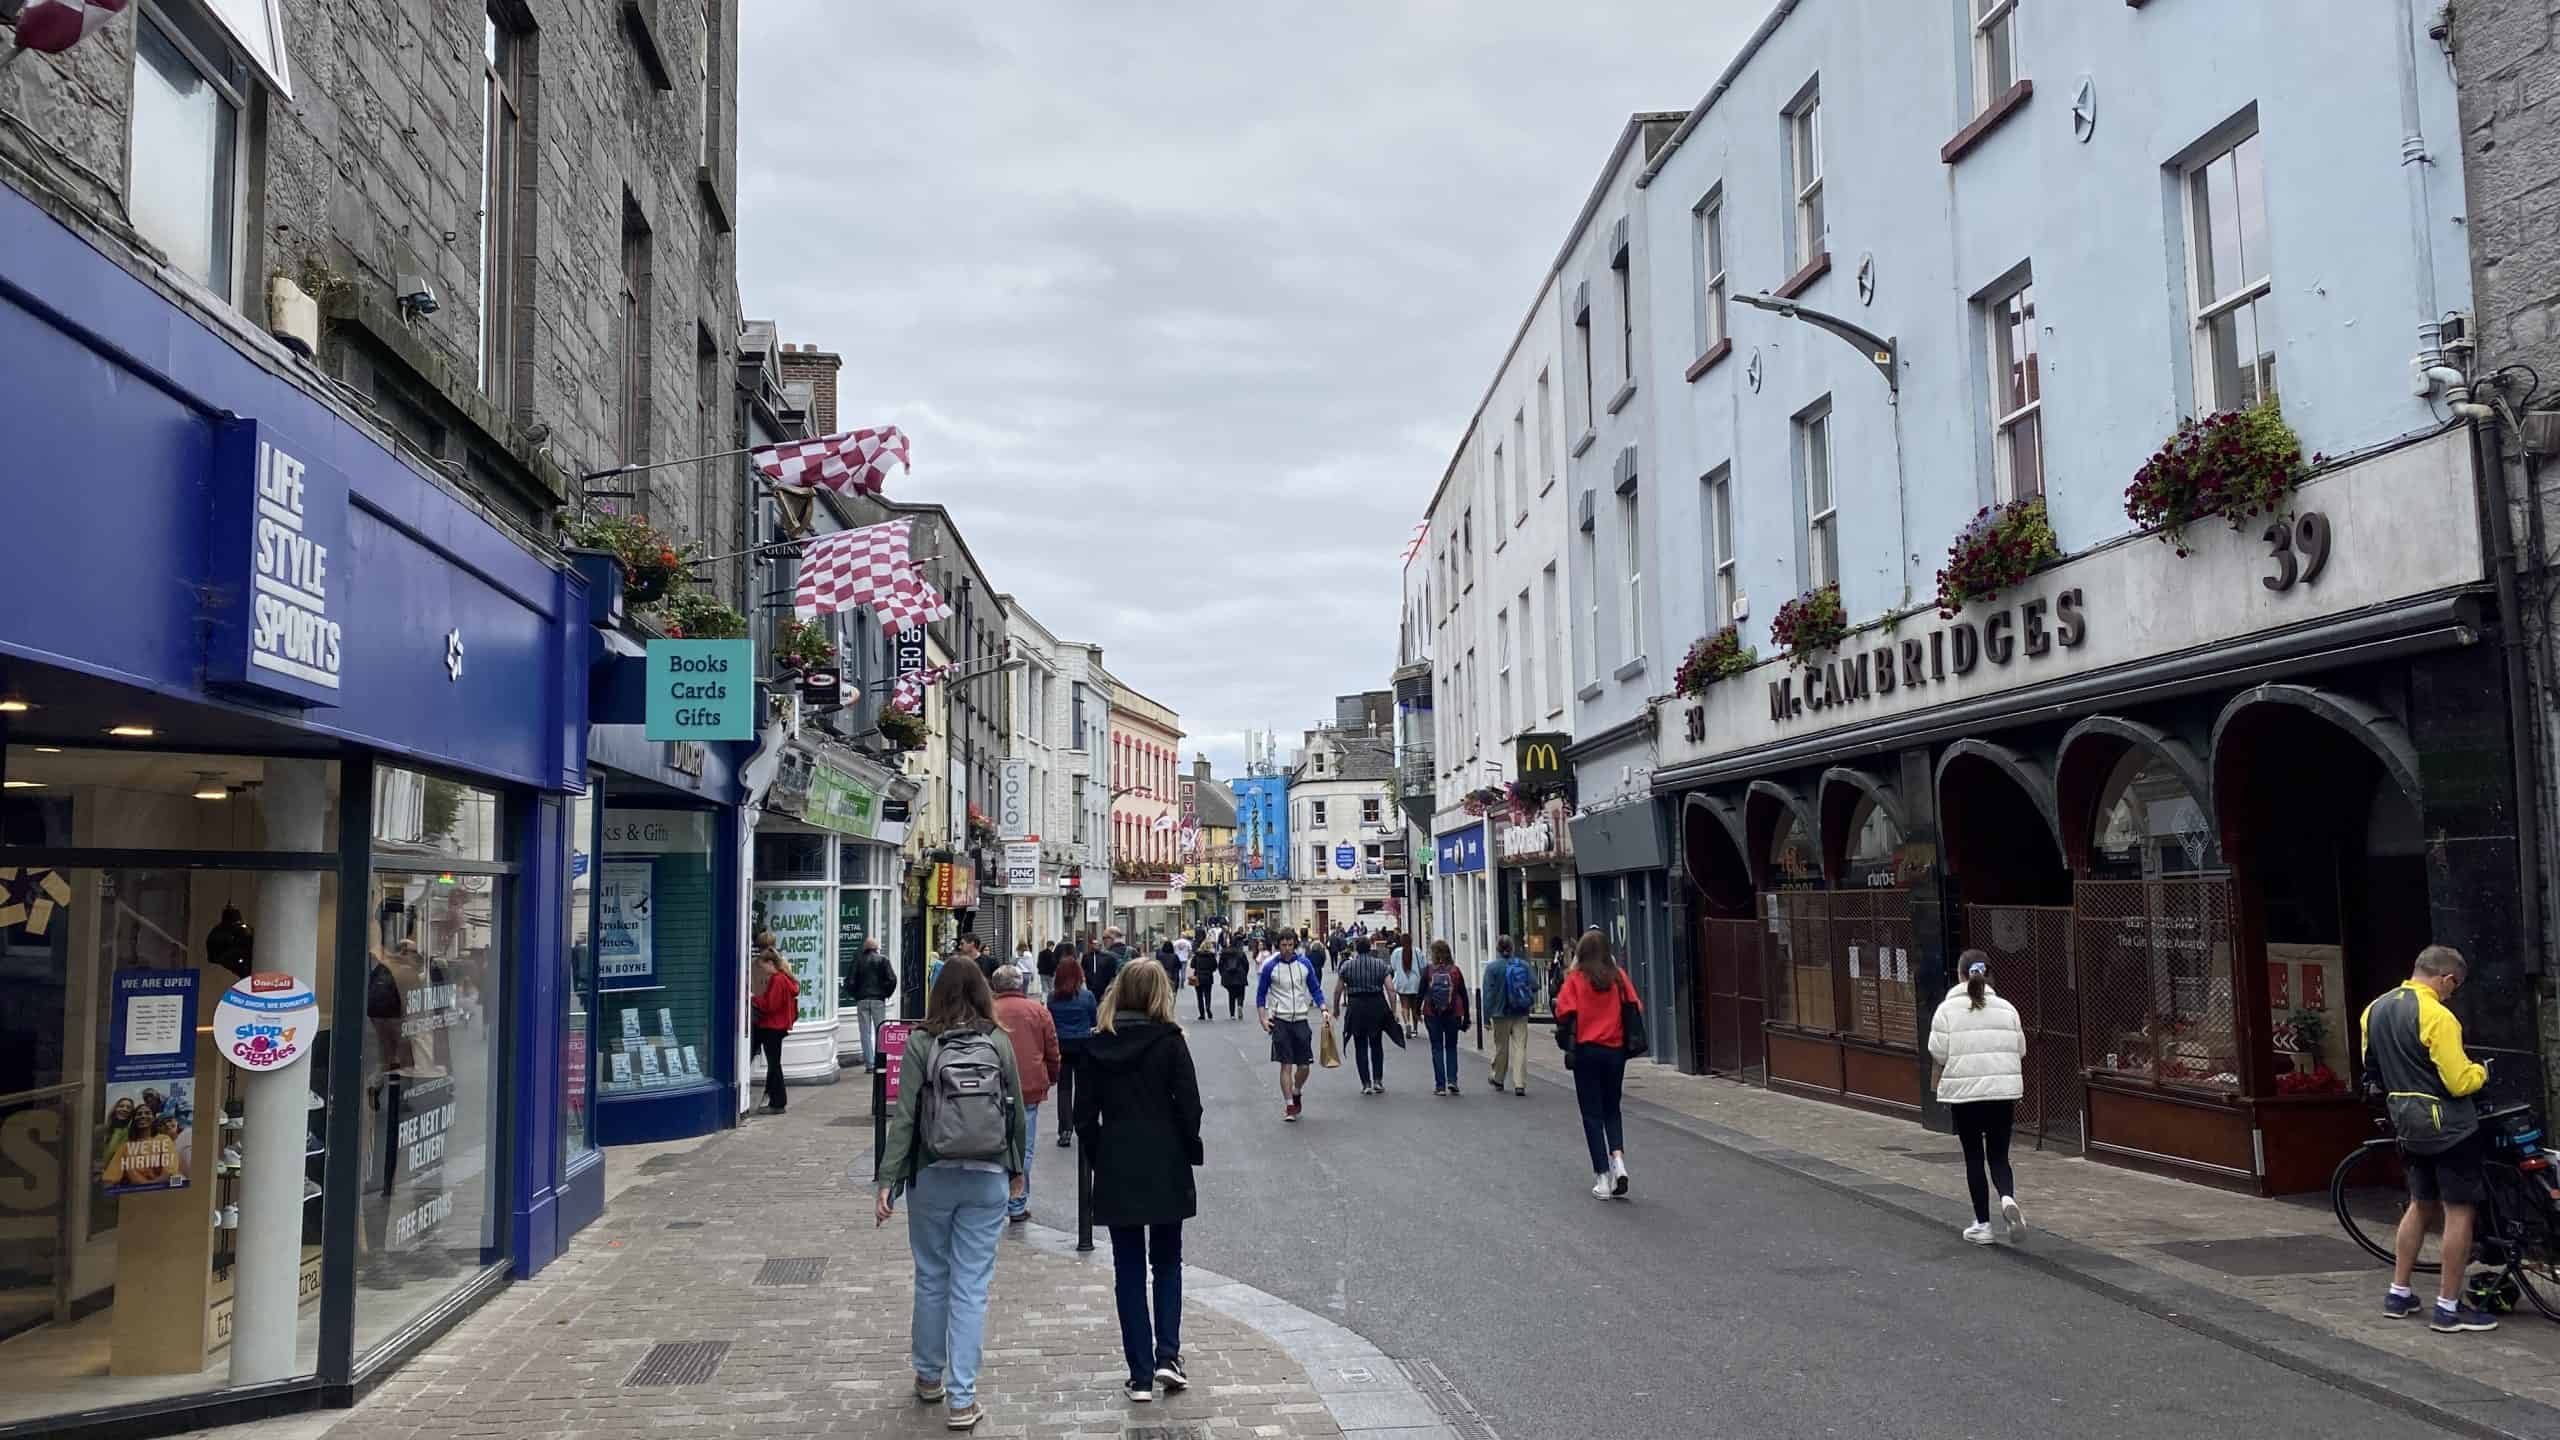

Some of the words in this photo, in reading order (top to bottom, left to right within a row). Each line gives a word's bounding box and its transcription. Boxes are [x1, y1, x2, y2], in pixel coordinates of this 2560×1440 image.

[258, 440, 305, 515] LIFE
[256, 517, 328, 600] STYLE
[2262, 511, 2332, 592] 39
[253, 593, 341, 673] SPORTS
[669, 654, 729, 673] Books
[670, 681, 727, 700] Cards
[675, 707, 721, 726] Gifts
[1684, 704, 1706, 744] 38
[626, 823, 640, 841] &
[615, 962, 647, 974] BOYNE
[121, 978, 139, 989] WE
[141, 978, 162, 989] ARE
[164, 976, 193, 988] OPEN
[235, 1023, 283, 1040] Shop
[233, 1042, 297, 1066] Giggles
[398, 1116, 418, 1150] FREE
[420, 1108, 441, 1139] NEXT
[442, 1101, 456, 1131] DAY
[126, 1138, 169, 1154] WE'RE
[408, 1132, 447, 1173] DELIVERY
[120, 1152, 176, 1171] HIRING!
[395, 1210, 417, 1246] FREE
